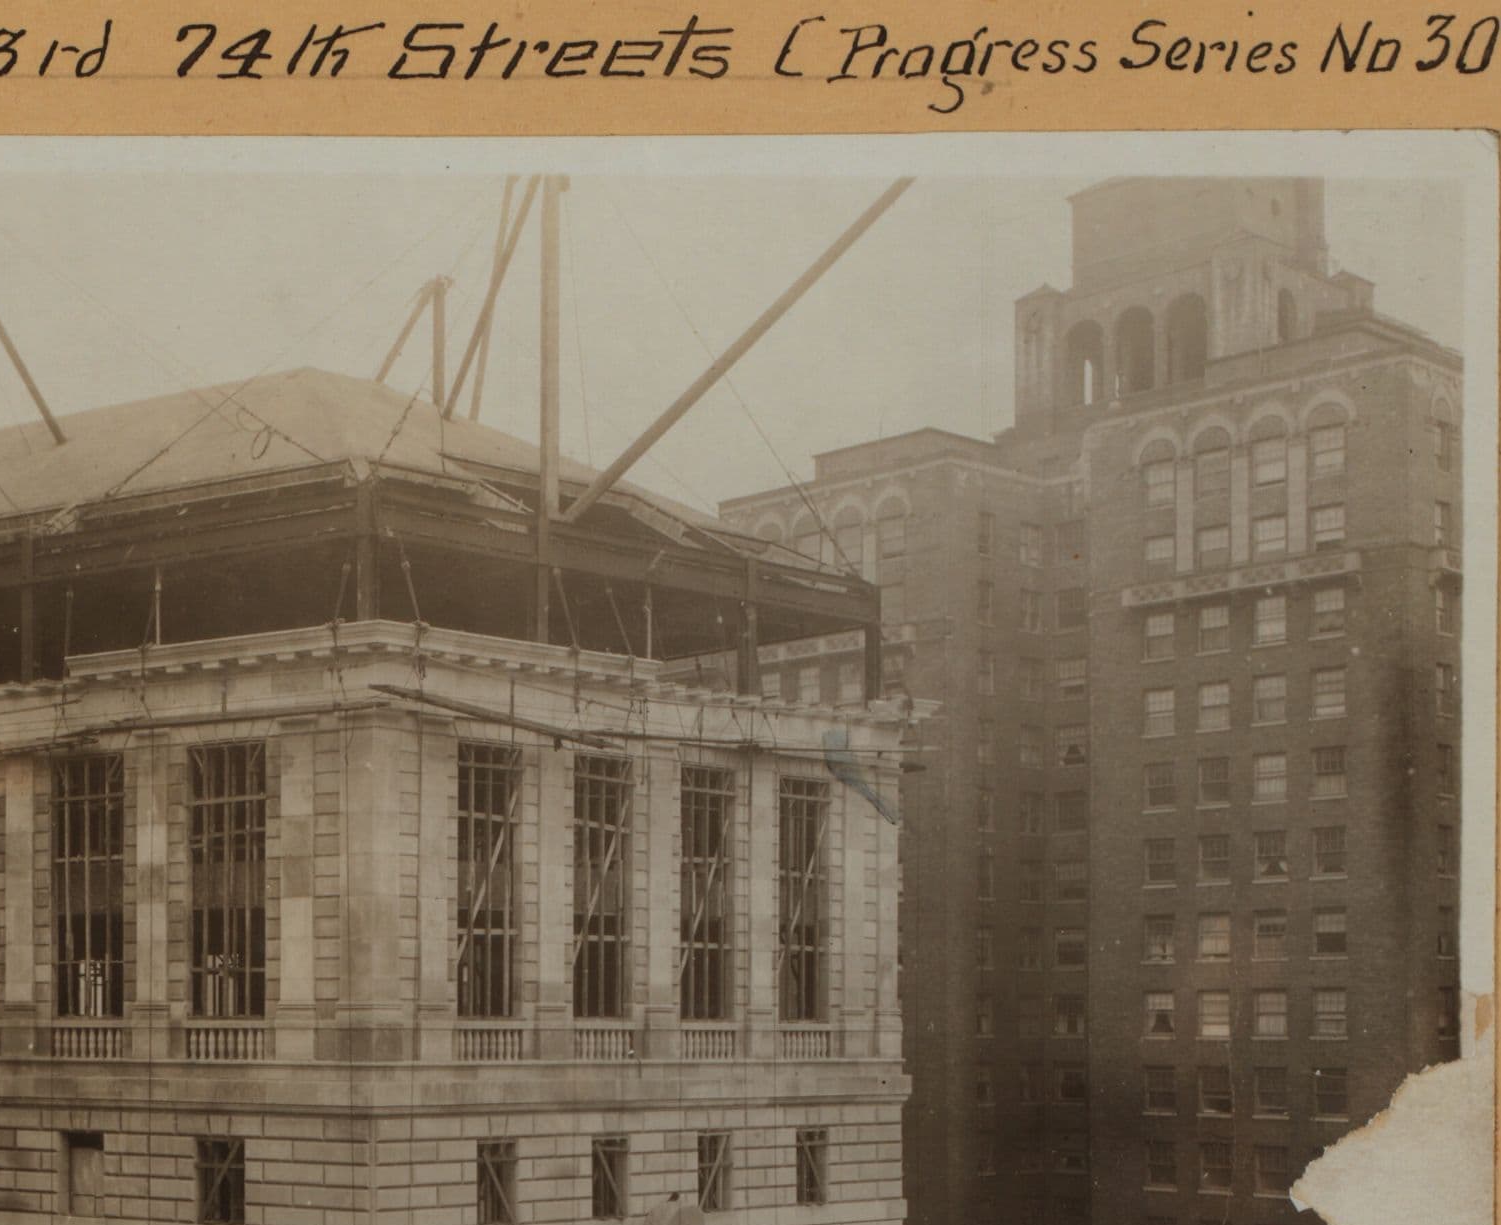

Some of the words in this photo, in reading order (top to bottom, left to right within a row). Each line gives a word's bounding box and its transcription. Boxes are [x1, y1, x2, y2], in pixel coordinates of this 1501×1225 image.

[175, 22, 386, 79] 74th
[387, 15, 733, 80] Streets
[1119, 10, 1298, 74] Series
[1320, 20, 1402, 74] No
